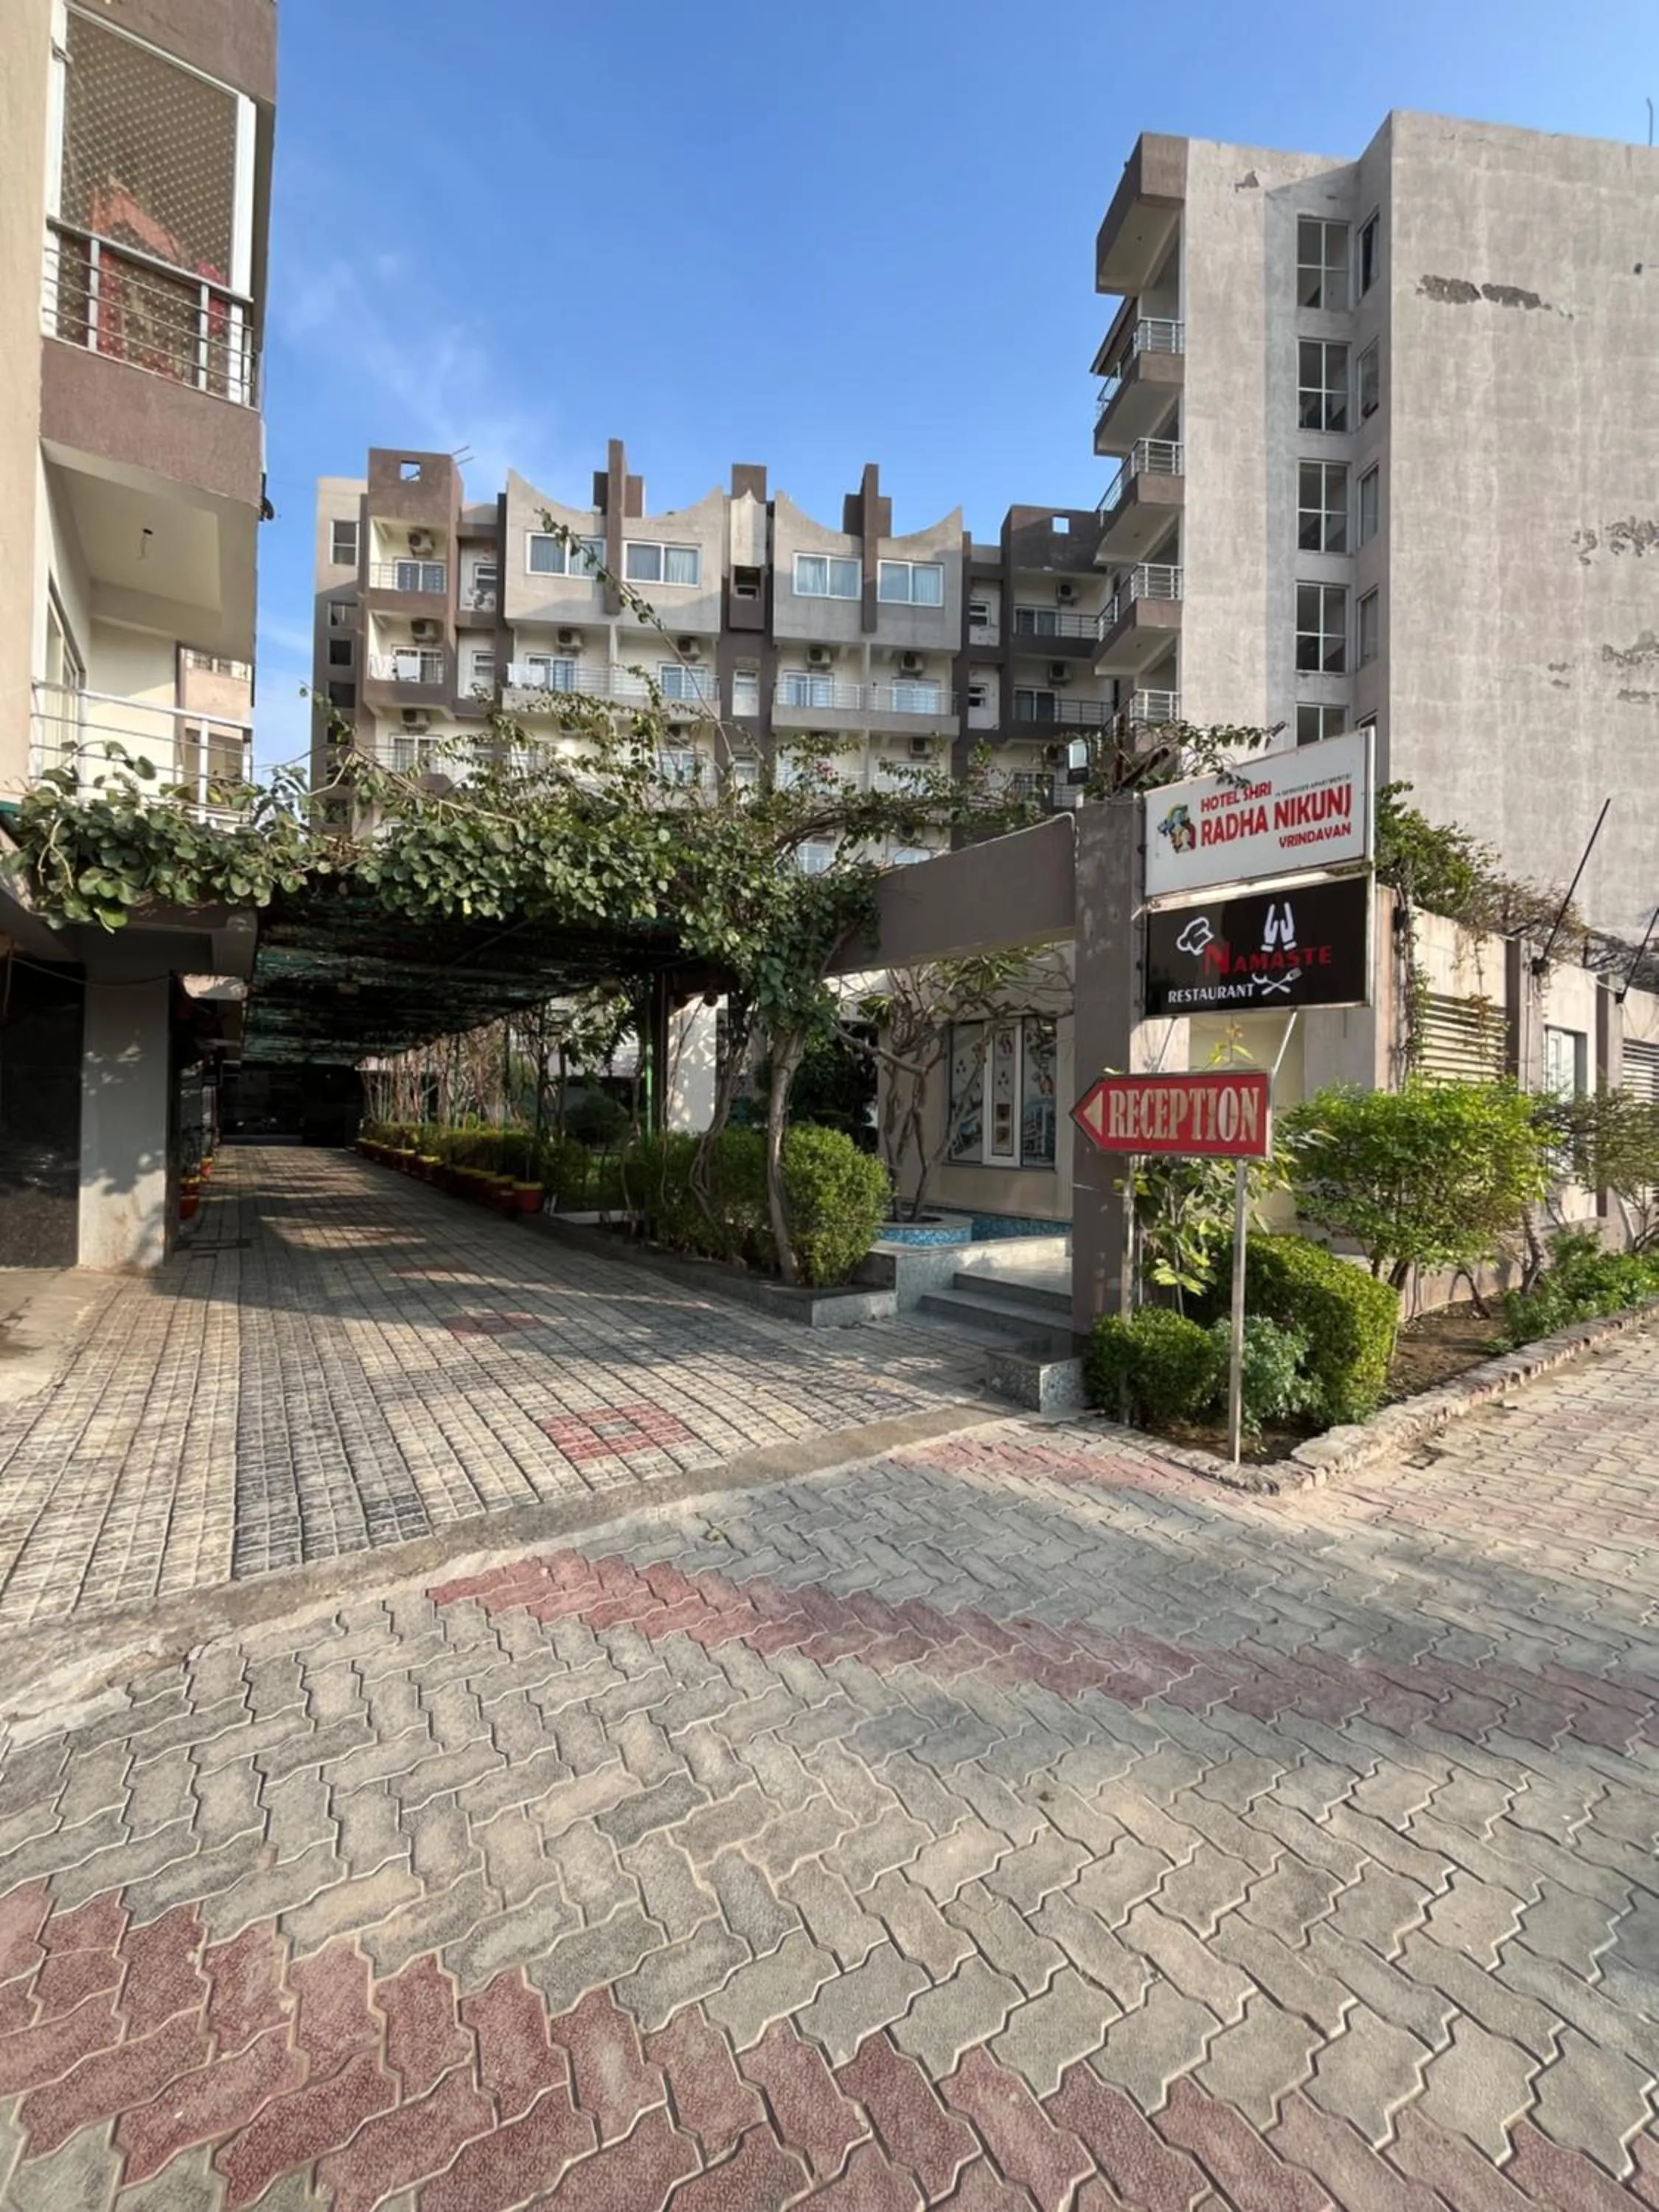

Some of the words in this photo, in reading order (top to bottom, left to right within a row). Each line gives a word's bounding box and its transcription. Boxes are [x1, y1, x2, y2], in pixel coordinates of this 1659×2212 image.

[1200, 790, 1239, 813] HOTEL
[1243, 781, 1272, 801] SHRI
[1200, 804, 1269, 846] RADHA
[1274, 783, 1352, 830] NIKUNJ
[1279, 822, 1352, 849] VRINDAVAN
[1203, 942, 1332, 975] NAMASTE
[1168, 984, 1255, 1004] RESTAURANT
[1107, 1087, 1260, 1142] RECEPTION
